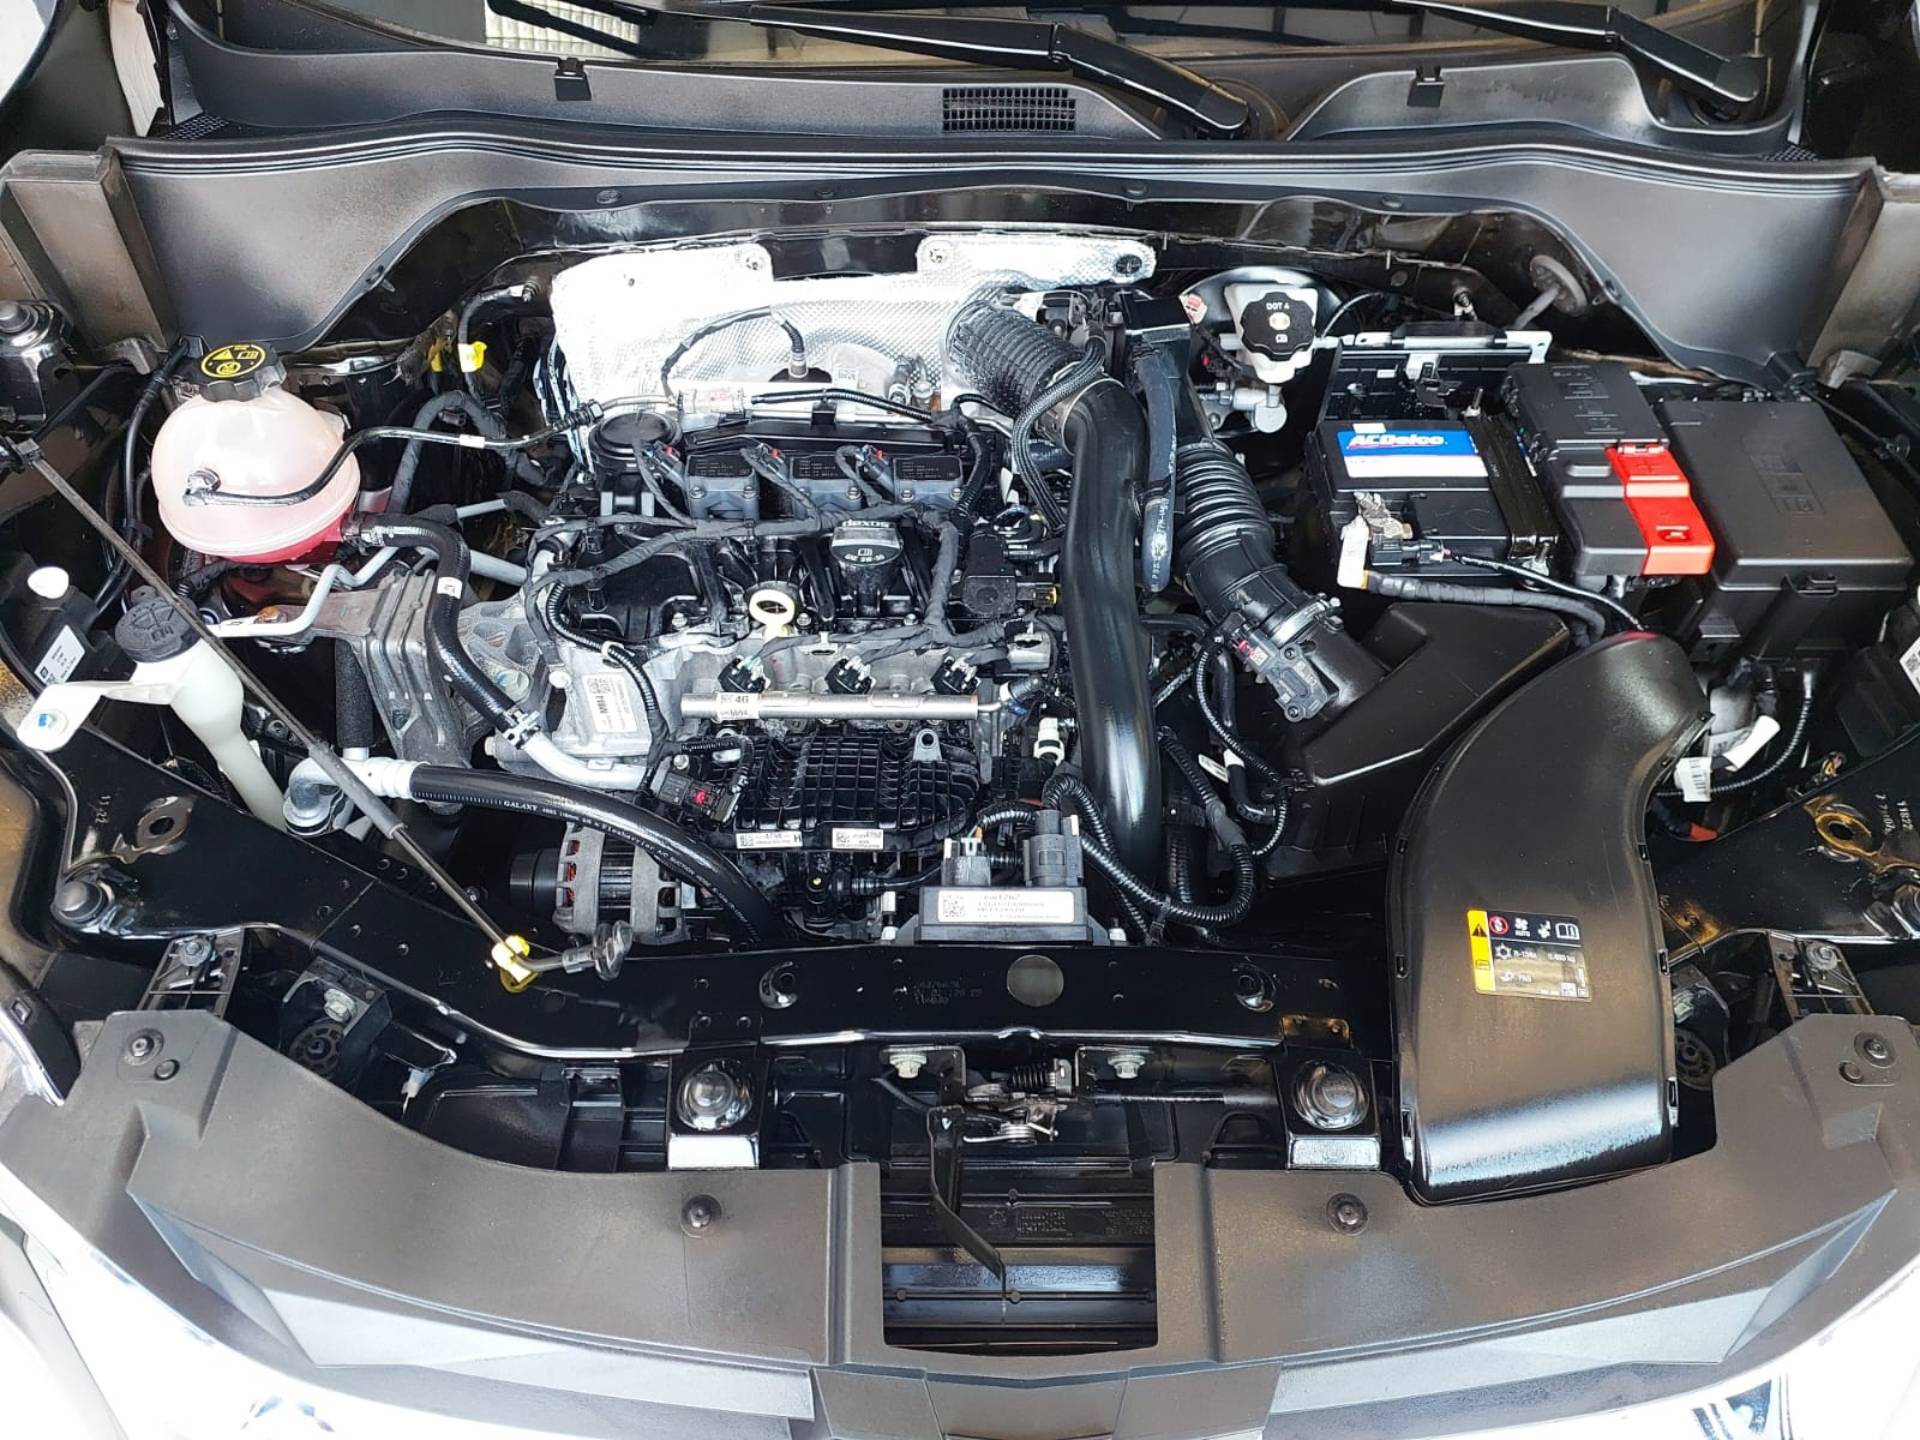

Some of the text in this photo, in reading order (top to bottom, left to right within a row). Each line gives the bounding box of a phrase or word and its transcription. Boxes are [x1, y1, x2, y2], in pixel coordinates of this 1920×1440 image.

[1266, 302, 1283, 310] DOT
[1348, 434, 1445, 447] ACDelco
[842, 519, 889, 528] dexos
[503, 800, 539, 812] GALAXY
